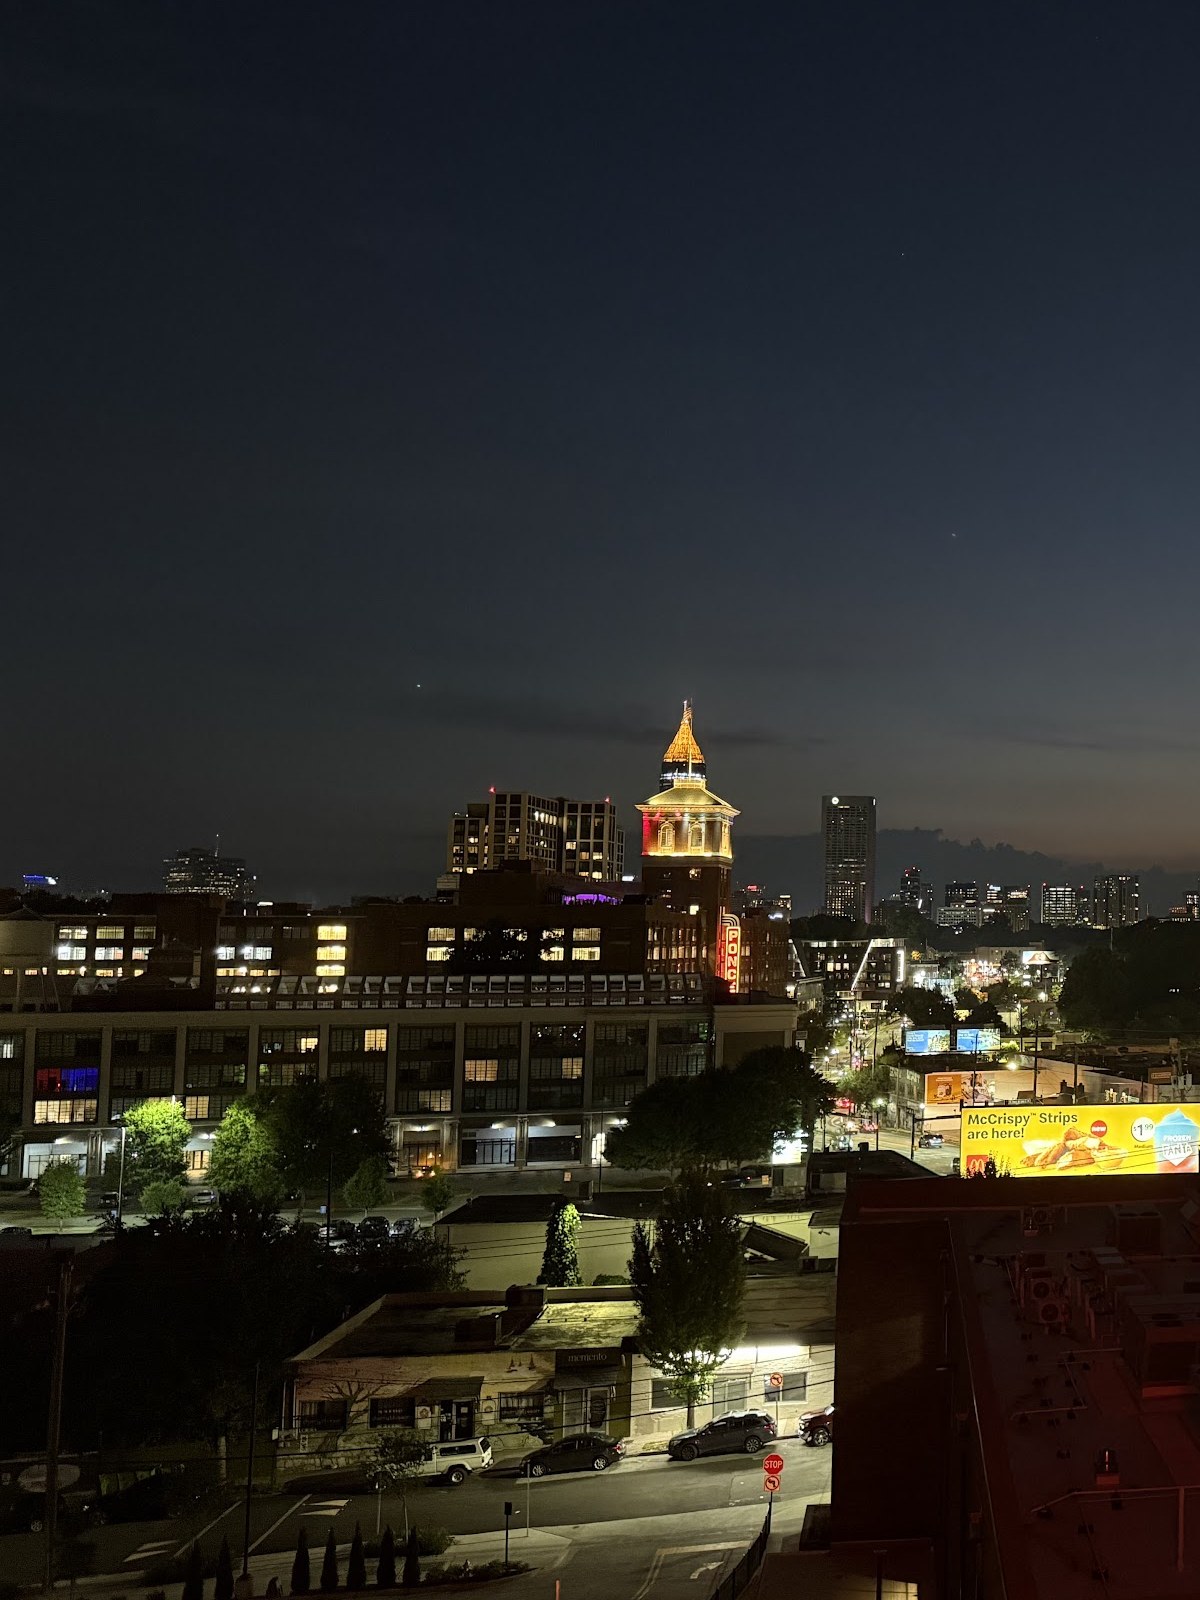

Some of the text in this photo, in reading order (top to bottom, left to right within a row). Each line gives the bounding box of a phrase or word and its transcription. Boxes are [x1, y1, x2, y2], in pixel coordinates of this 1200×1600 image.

[1039, 1111, 1078, 1125] Strips
[967, 1126, 1024, 1140] are here!
[1163, 1144, 1193, 1156] FANTA
[568, 1353, 607, 1361] memento
[764, 1460, 783, 1469] STOP
